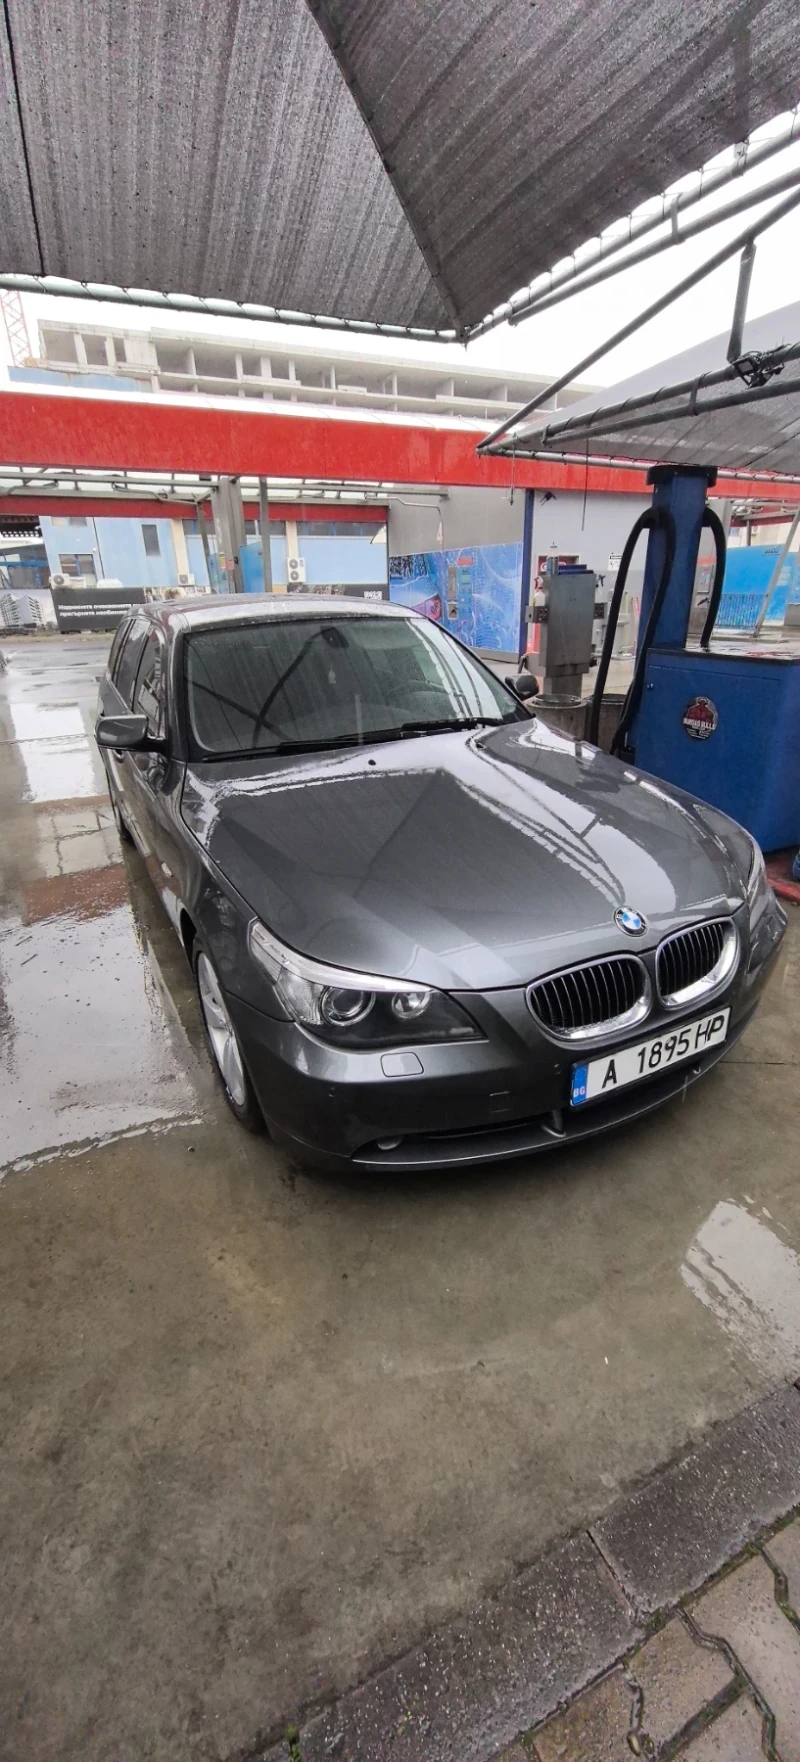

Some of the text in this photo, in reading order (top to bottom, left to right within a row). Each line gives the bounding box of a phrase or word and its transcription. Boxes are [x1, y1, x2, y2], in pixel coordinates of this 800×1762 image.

[601, 1014, 725, 1089] A 1895 HP
[572, 1086, 586, 1098] BG
